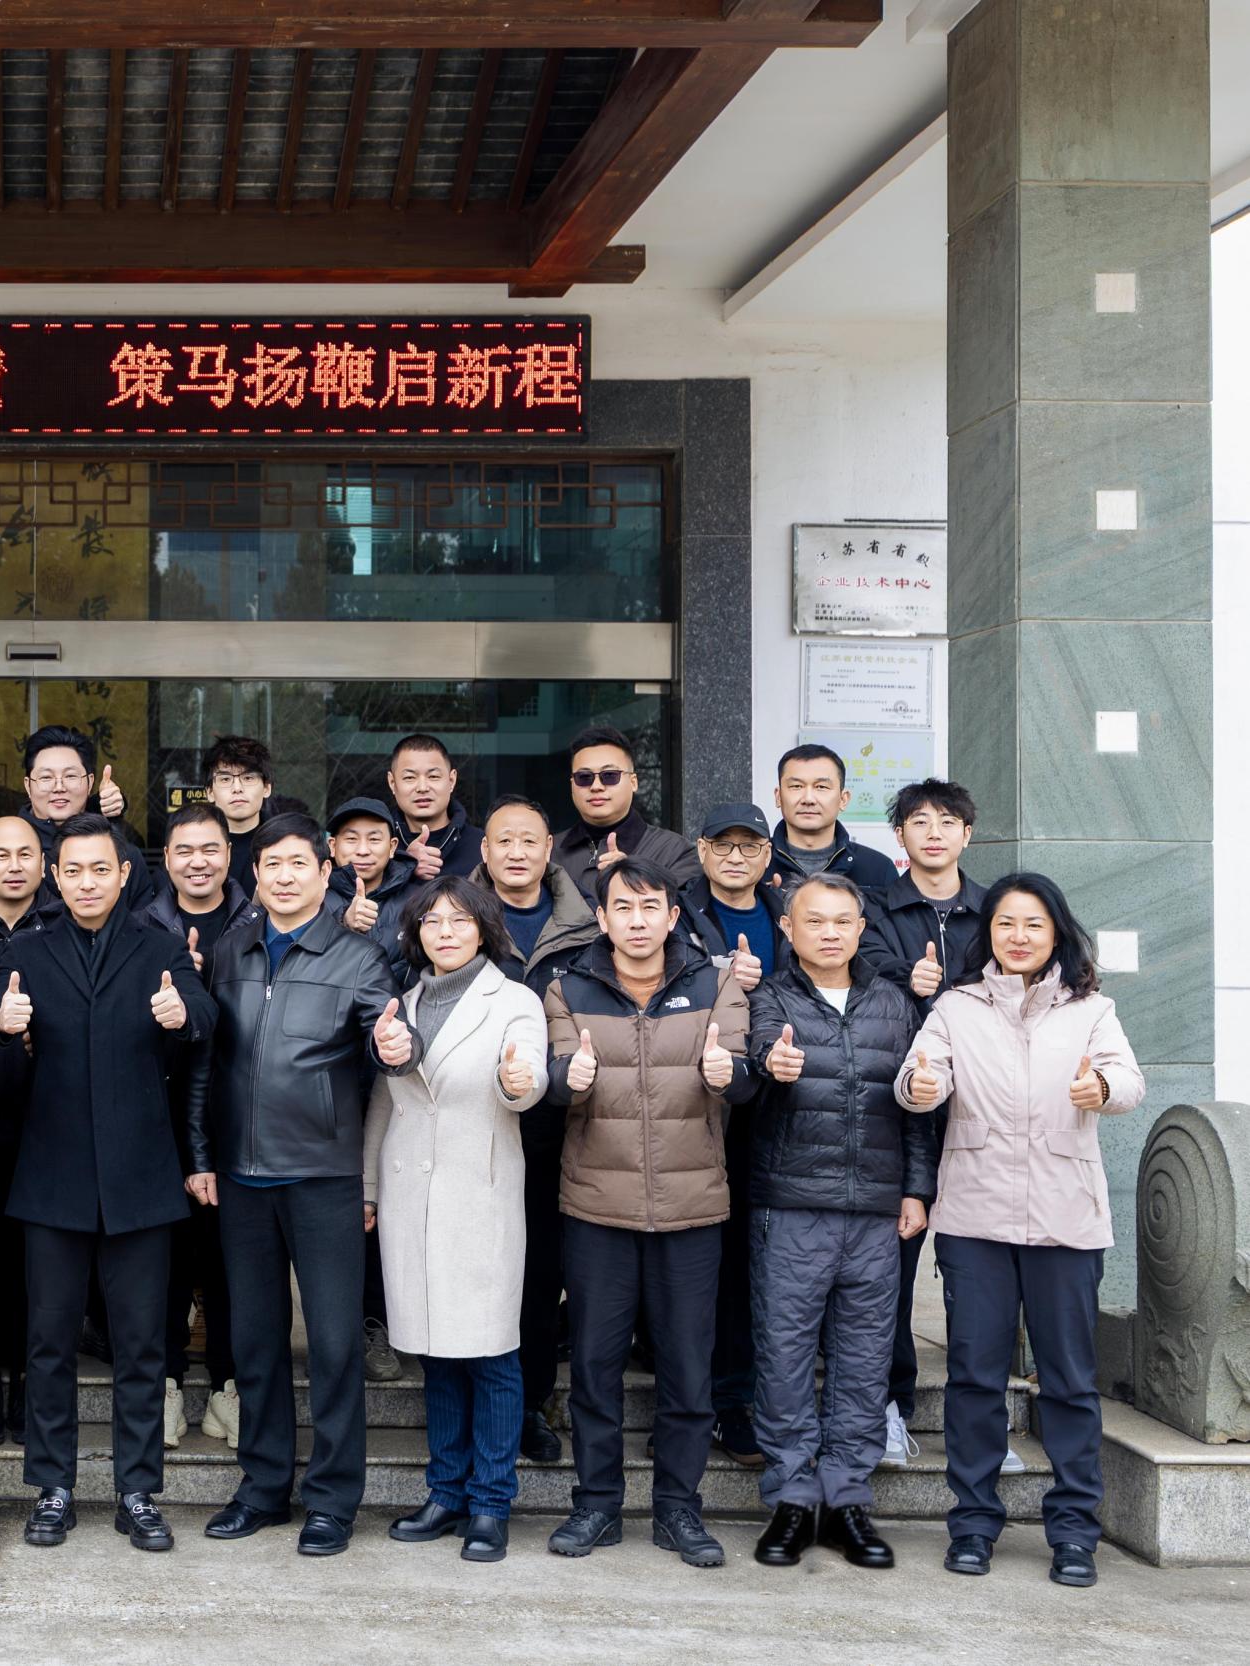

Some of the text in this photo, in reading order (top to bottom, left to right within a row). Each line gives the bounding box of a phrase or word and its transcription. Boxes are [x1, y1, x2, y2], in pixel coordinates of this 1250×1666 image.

[107, 341, 577, 409] 策马扬鞭启新程
[815, 576, 932, 590] 企业技术中心
